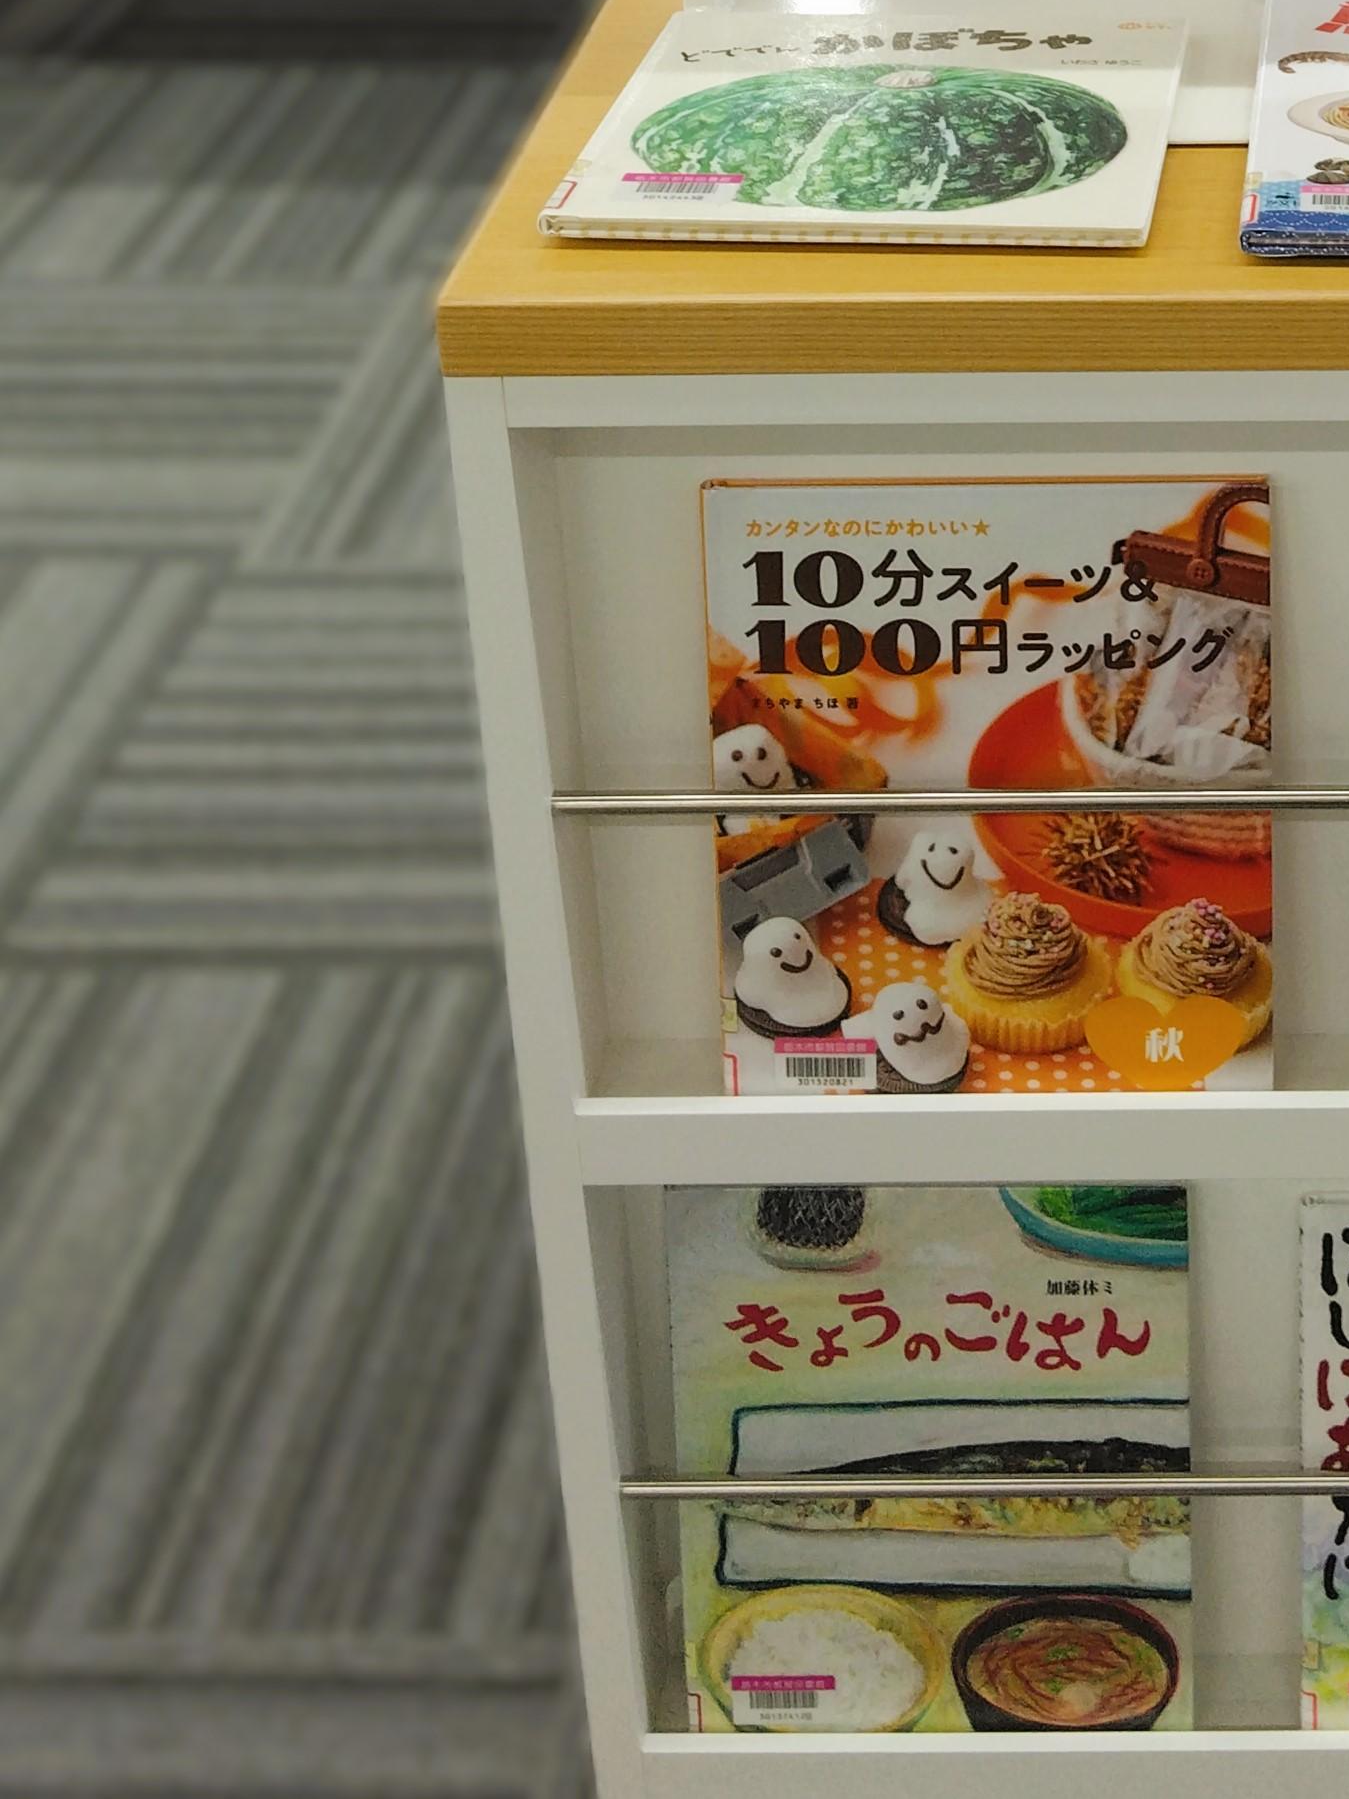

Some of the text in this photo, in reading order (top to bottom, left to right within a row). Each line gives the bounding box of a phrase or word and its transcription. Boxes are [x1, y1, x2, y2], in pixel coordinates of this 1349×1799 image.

[742, 618, 1234, 677] 100円ラッピング
[1145, 1028, 1185, 1063] 秋
[723, 1288, 1151, 1372] きょうのごはん
